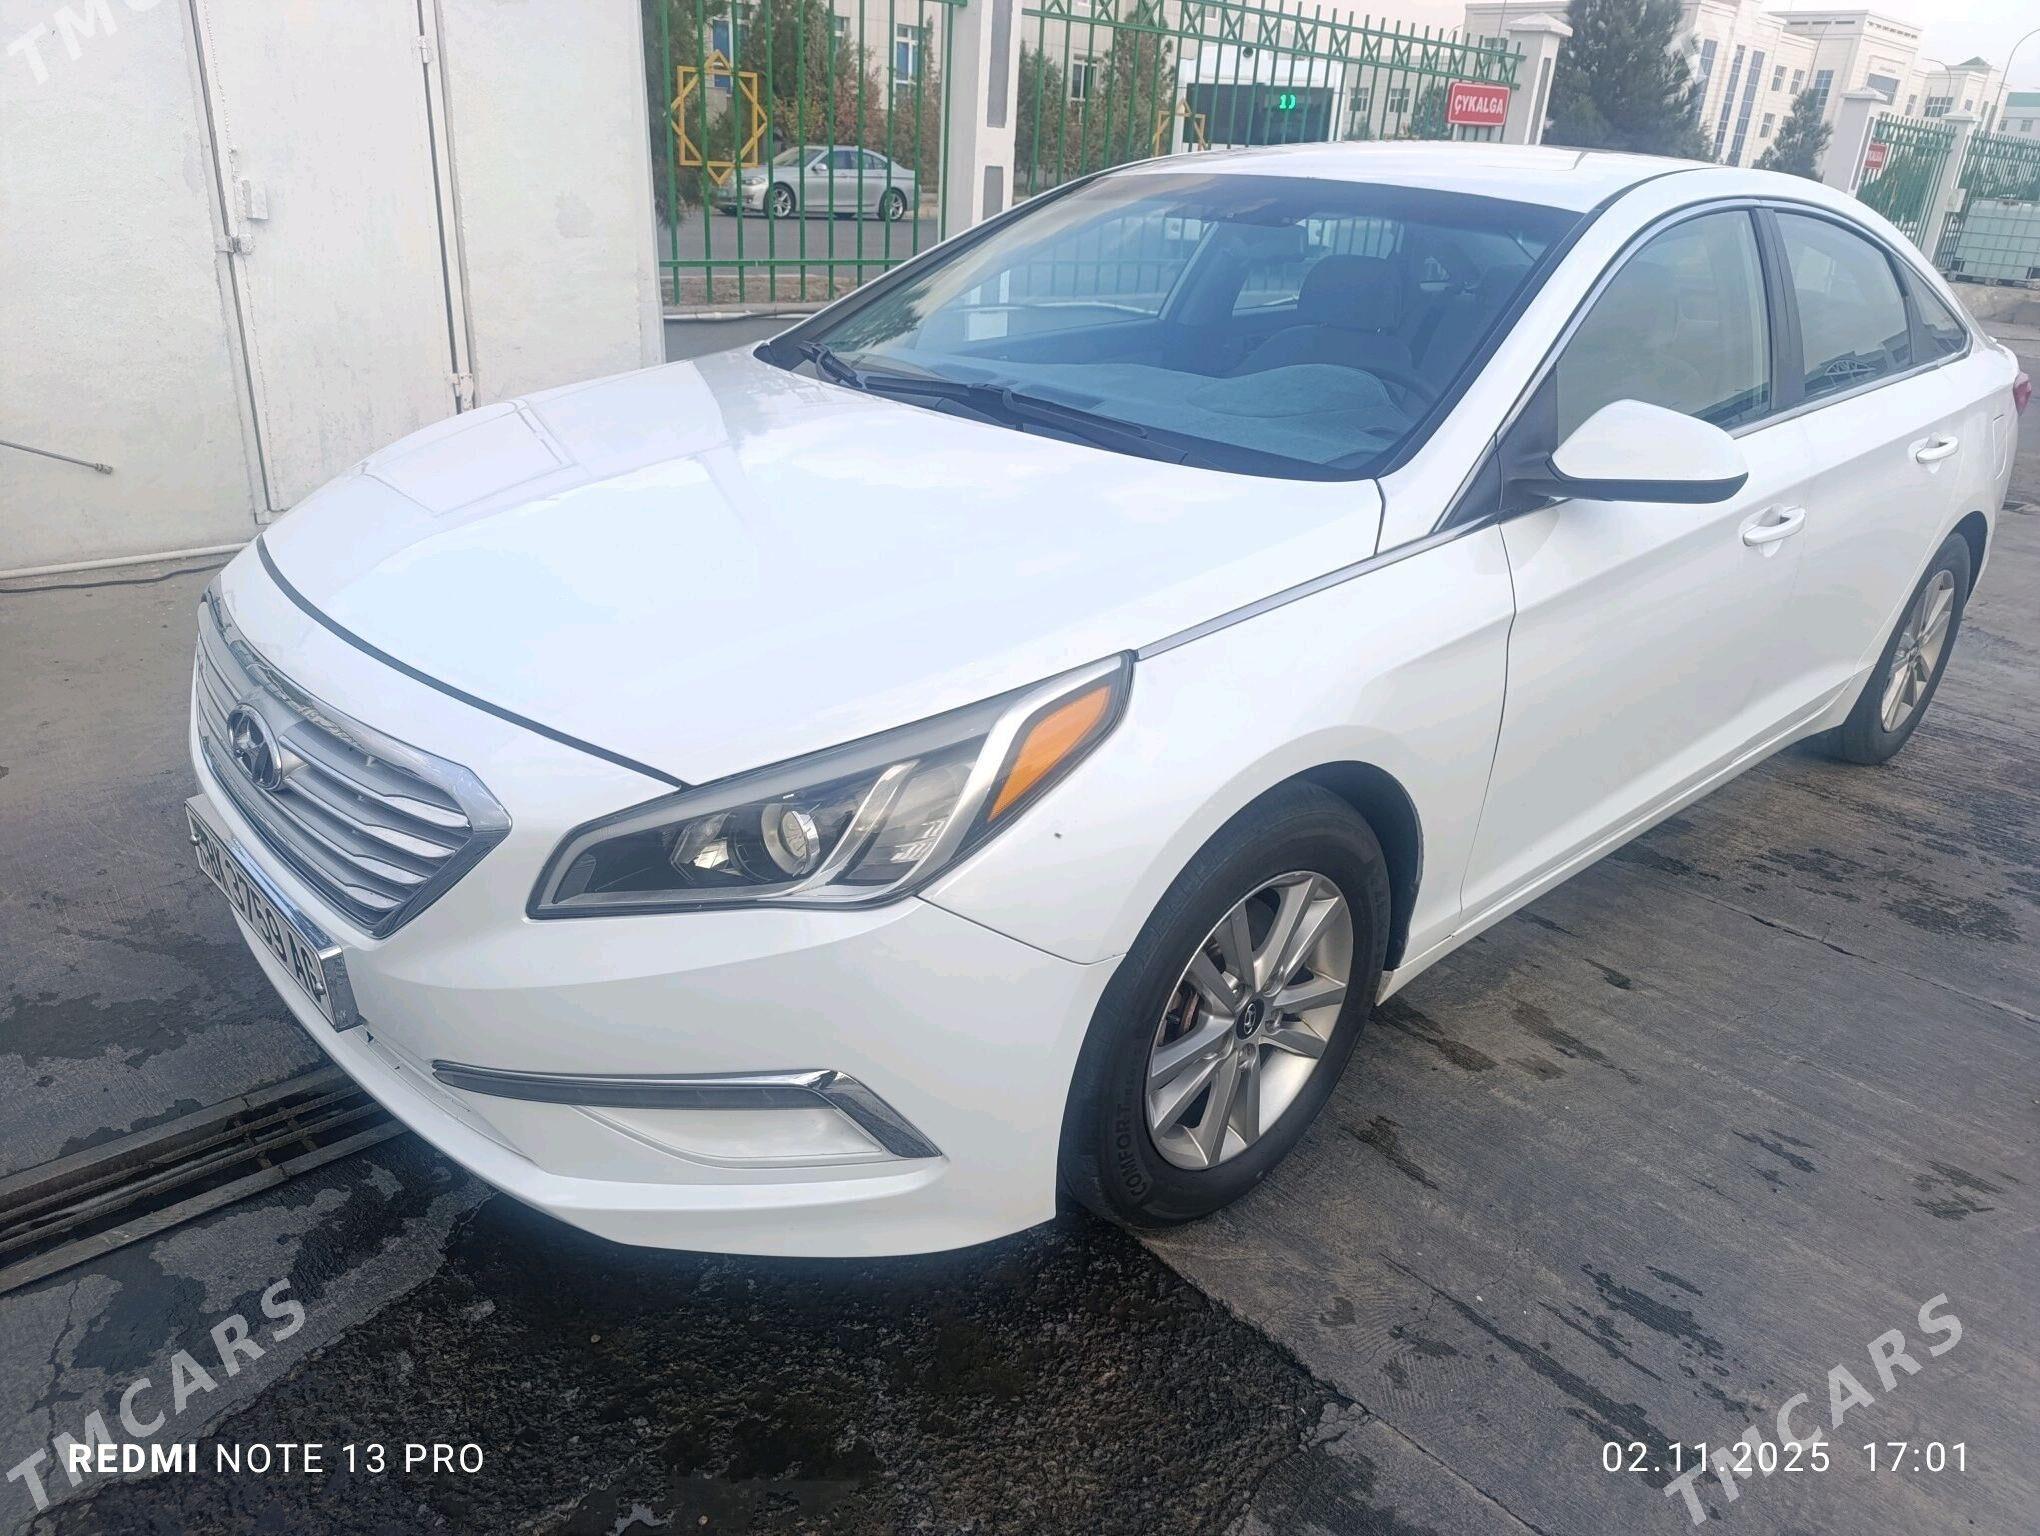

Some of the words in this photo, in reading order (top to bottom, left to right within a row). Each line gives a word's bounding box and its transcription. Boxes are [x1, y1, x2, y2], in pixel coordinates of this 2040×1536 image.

[1454, 95, 1503, 115] ÇYKALGA
[225, 859, 287, 963] 3759
[287, 930, 323, 1003] AG
[1116, 1103, 1147, 1196] COMFORT
